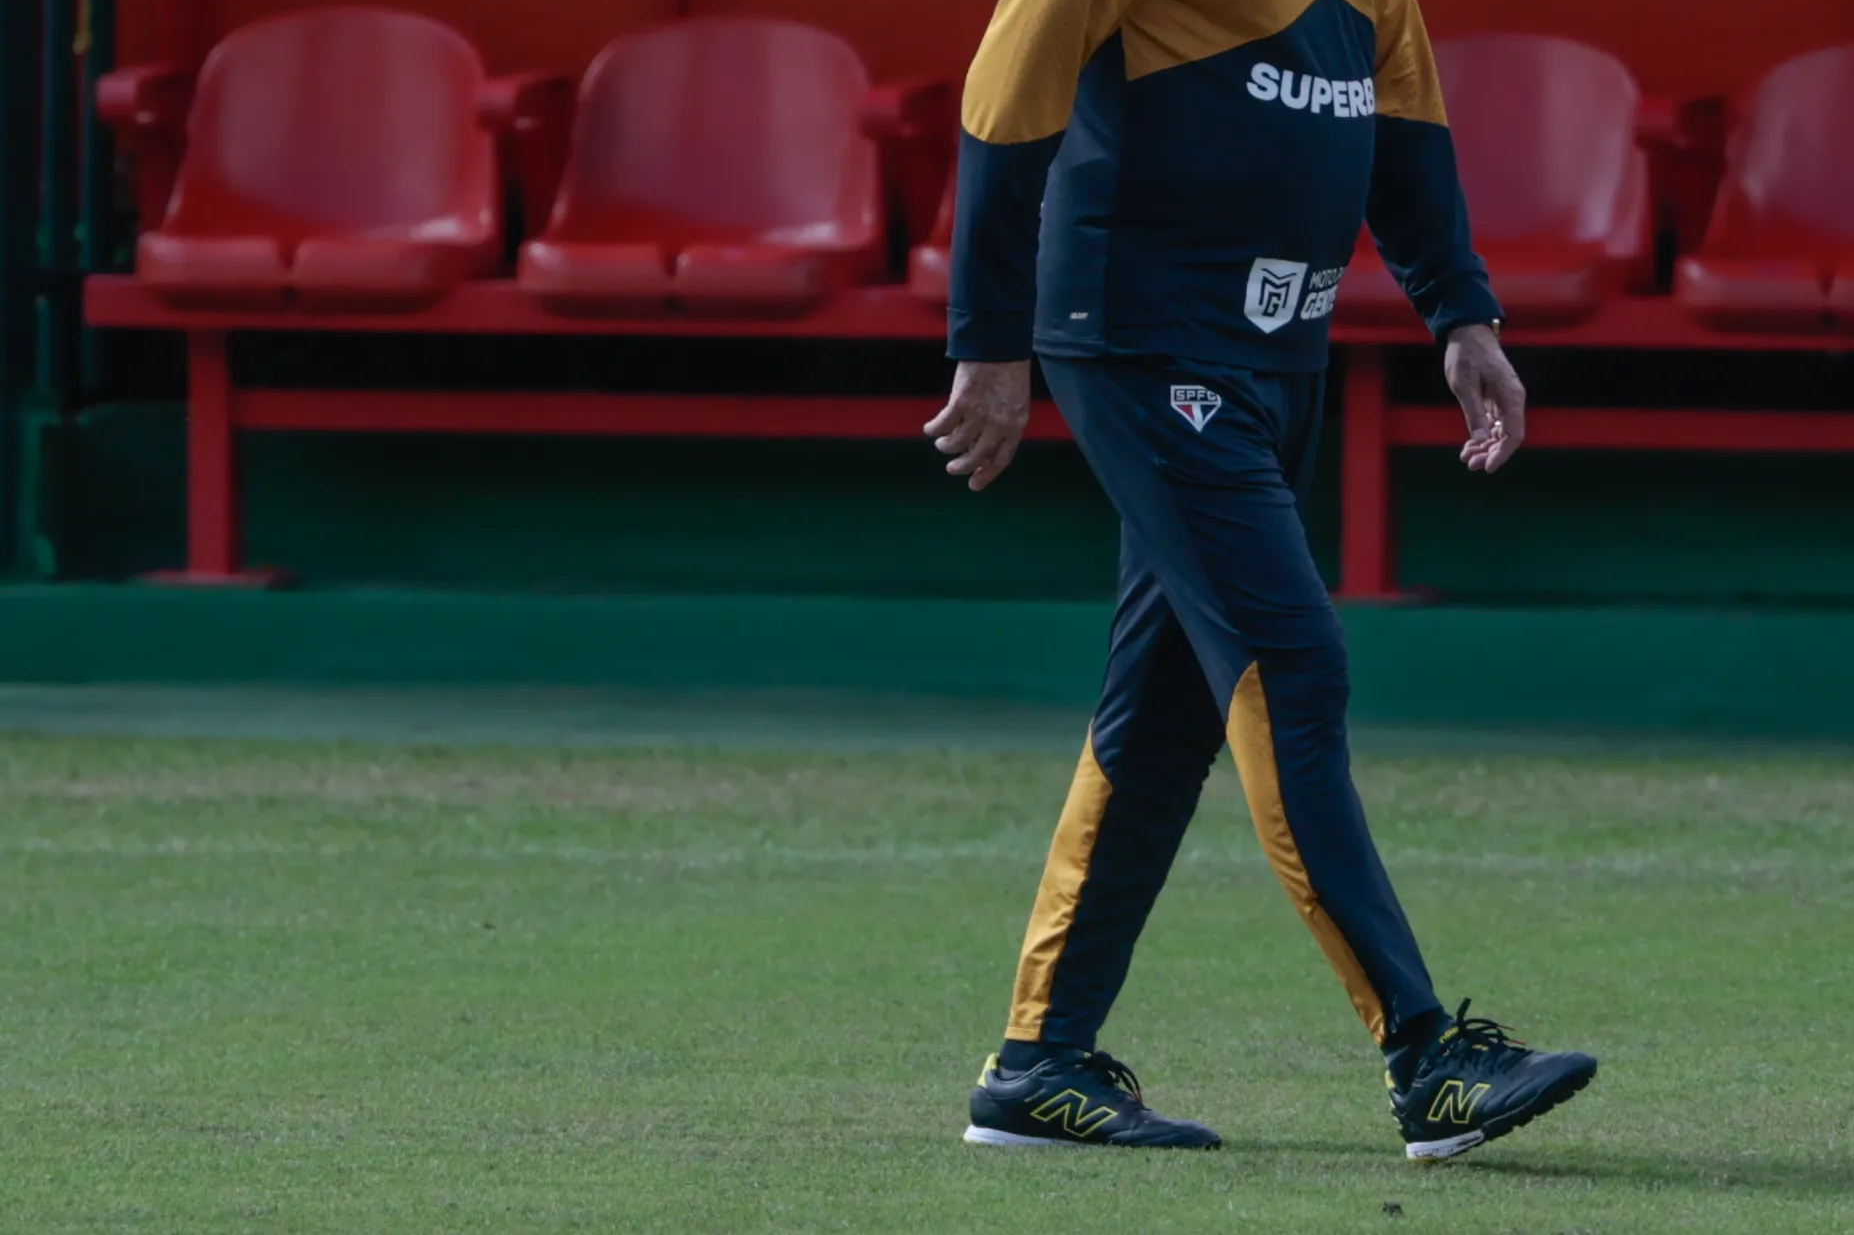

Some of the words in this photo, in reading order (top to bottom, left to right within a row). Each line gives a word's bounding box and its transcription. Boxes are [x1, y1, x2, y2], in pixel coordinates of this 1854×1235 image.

[1246, 62, 1376, 118] SUPERB
[1175, 389, 1218, 401] SPFC
[1030, 1088, 1118, 1138] N
[1425, 1079, 1492, 1125] N
